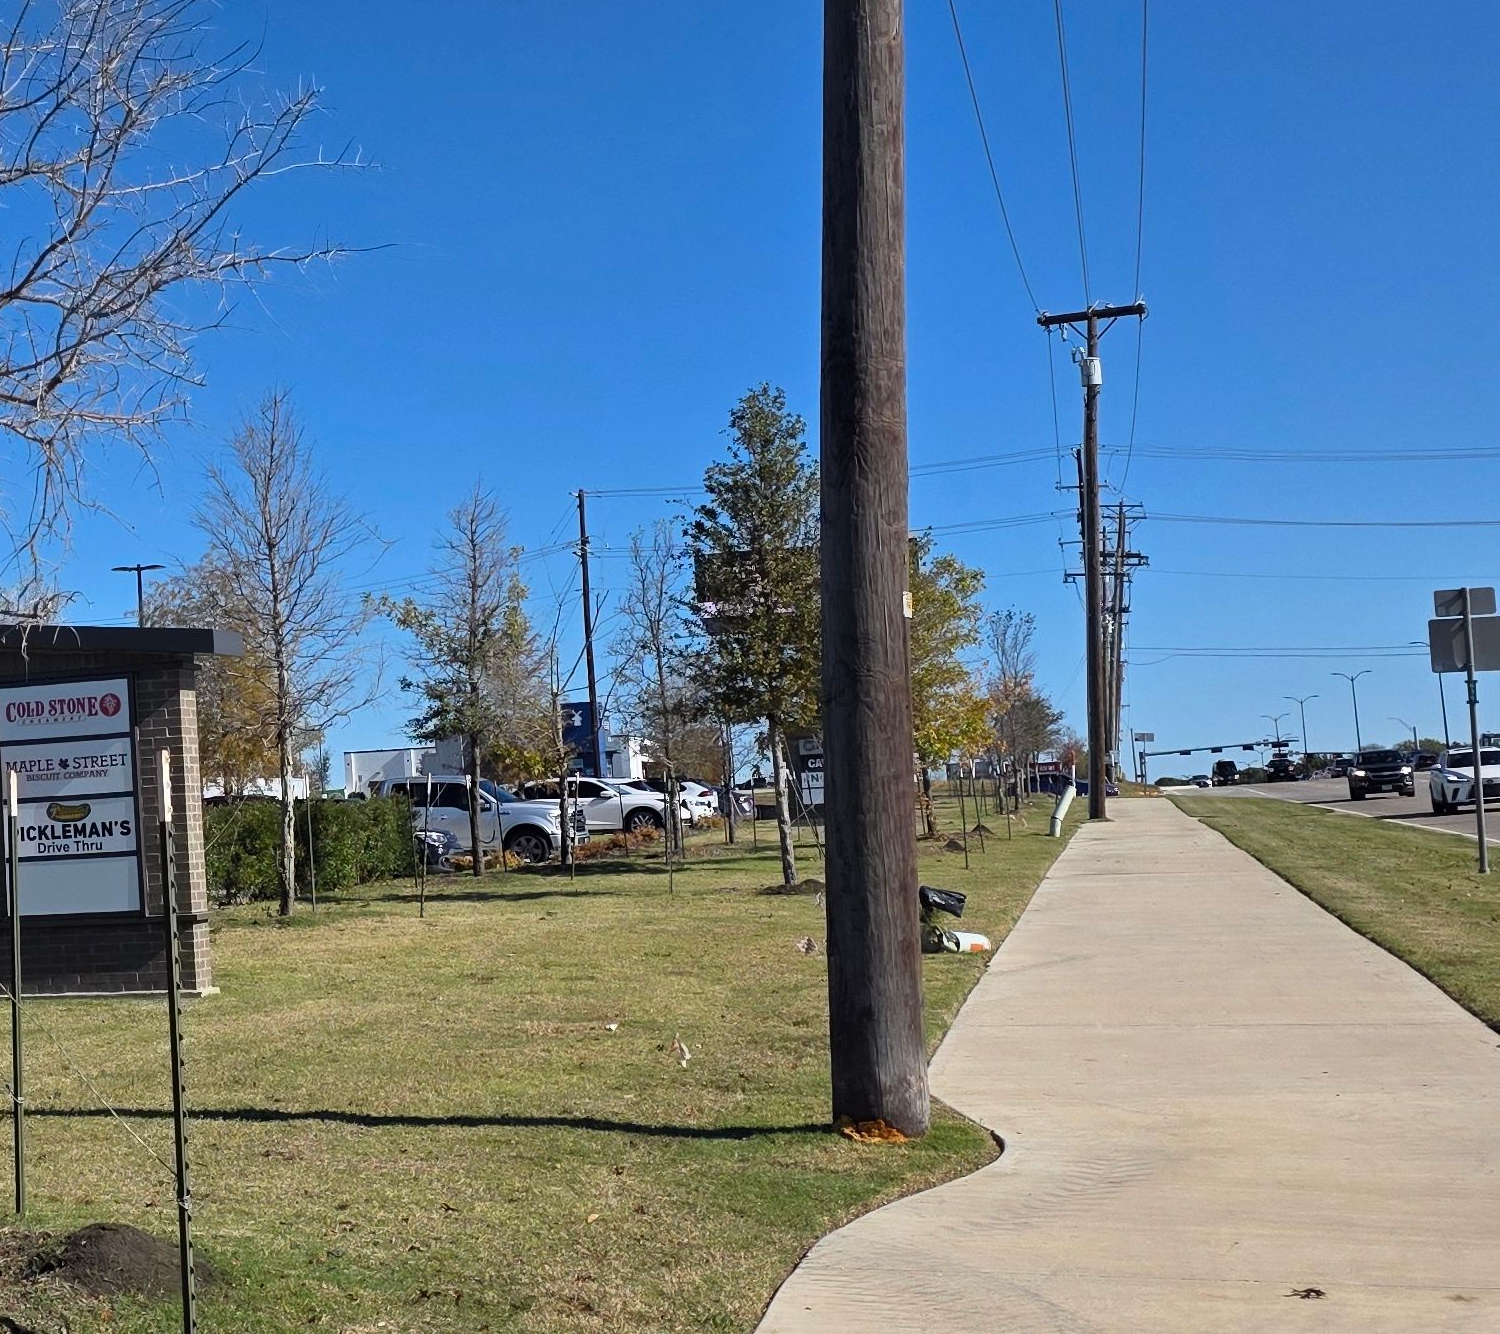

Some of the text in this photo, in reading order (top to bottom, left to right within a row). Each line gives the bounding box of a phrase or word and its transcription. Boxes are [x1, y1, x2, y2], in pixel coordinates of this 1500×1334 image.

[5, 696, 99, 723] COLD STONE
[5, 753, 128, 774] MAPLE STREET
[26, 769, 109, 782] BISCUIT COMPANY
[17, 820, 132, 842] ICKLEMAN'S
[37, 840, 103, 854] Drive Thru
